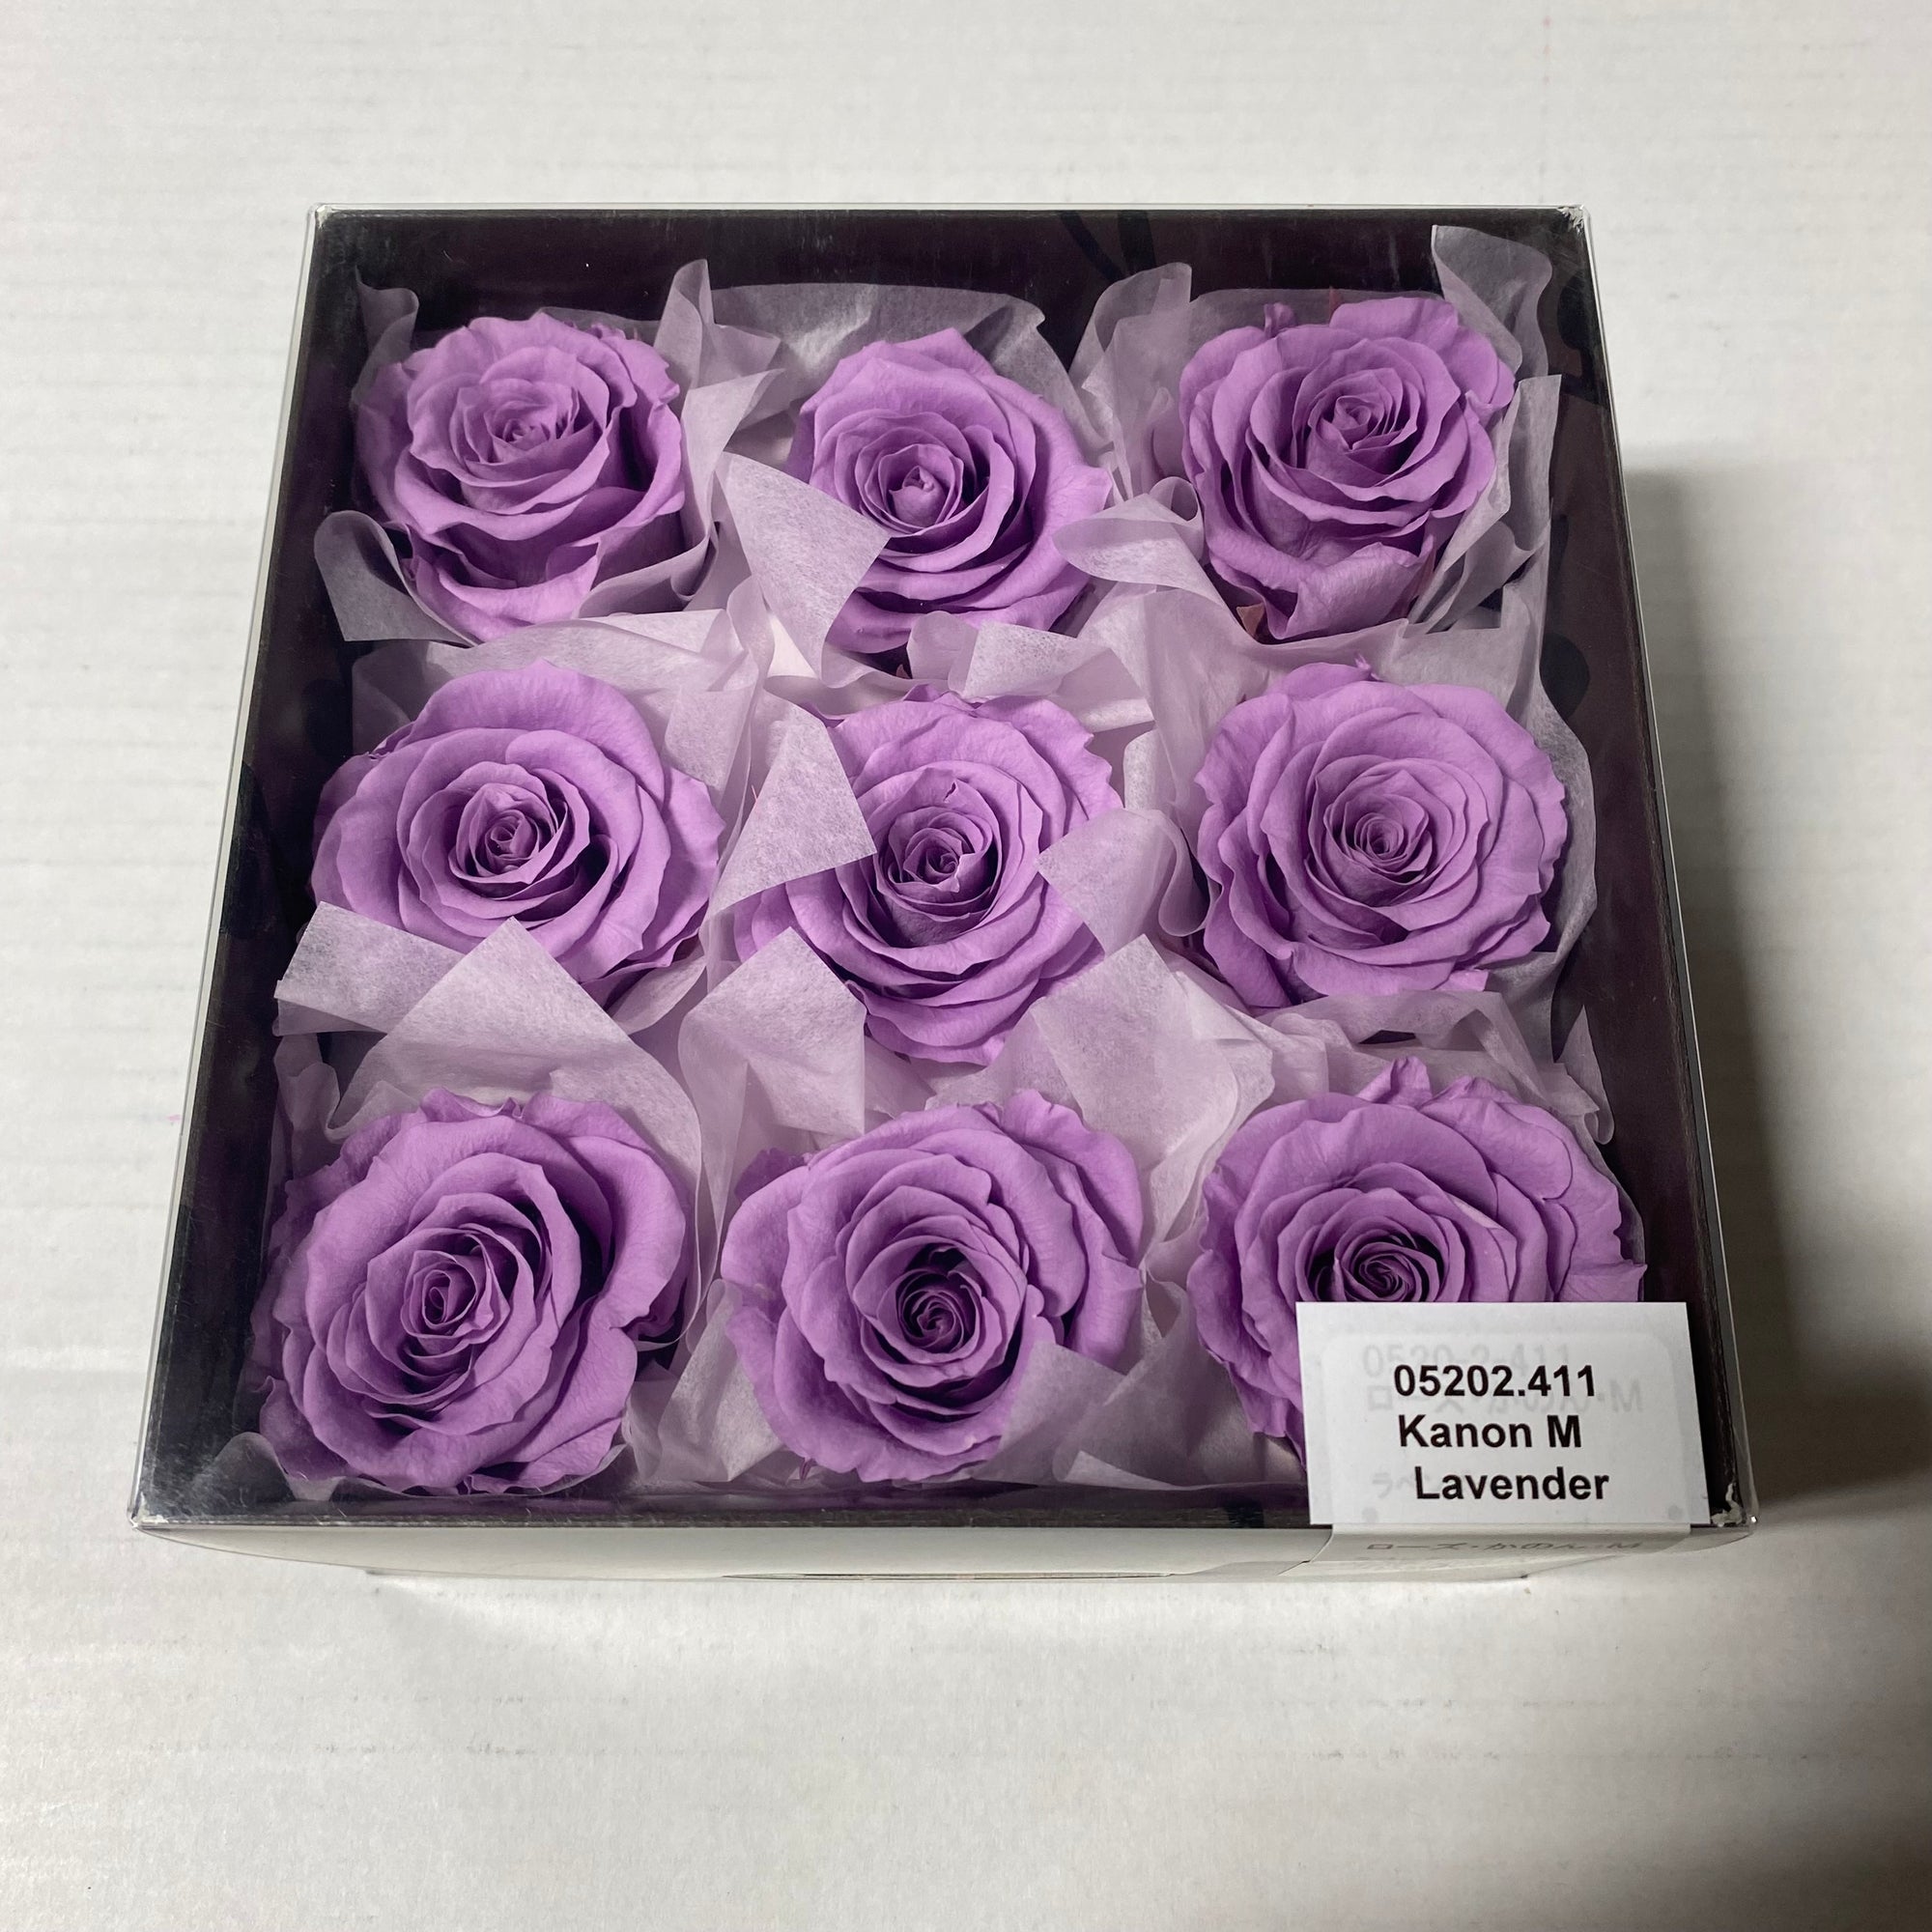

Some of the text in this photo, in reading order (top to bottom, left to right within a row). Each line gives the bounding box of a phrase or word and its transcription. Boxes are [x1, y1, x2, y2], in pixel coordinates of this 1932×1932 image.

[1394, 1364, 1595, 1397] 05202.411
[1398, 1414, 1582, 1448] Kanon M
[1414, 1465, 1610, 1500] Lavender
